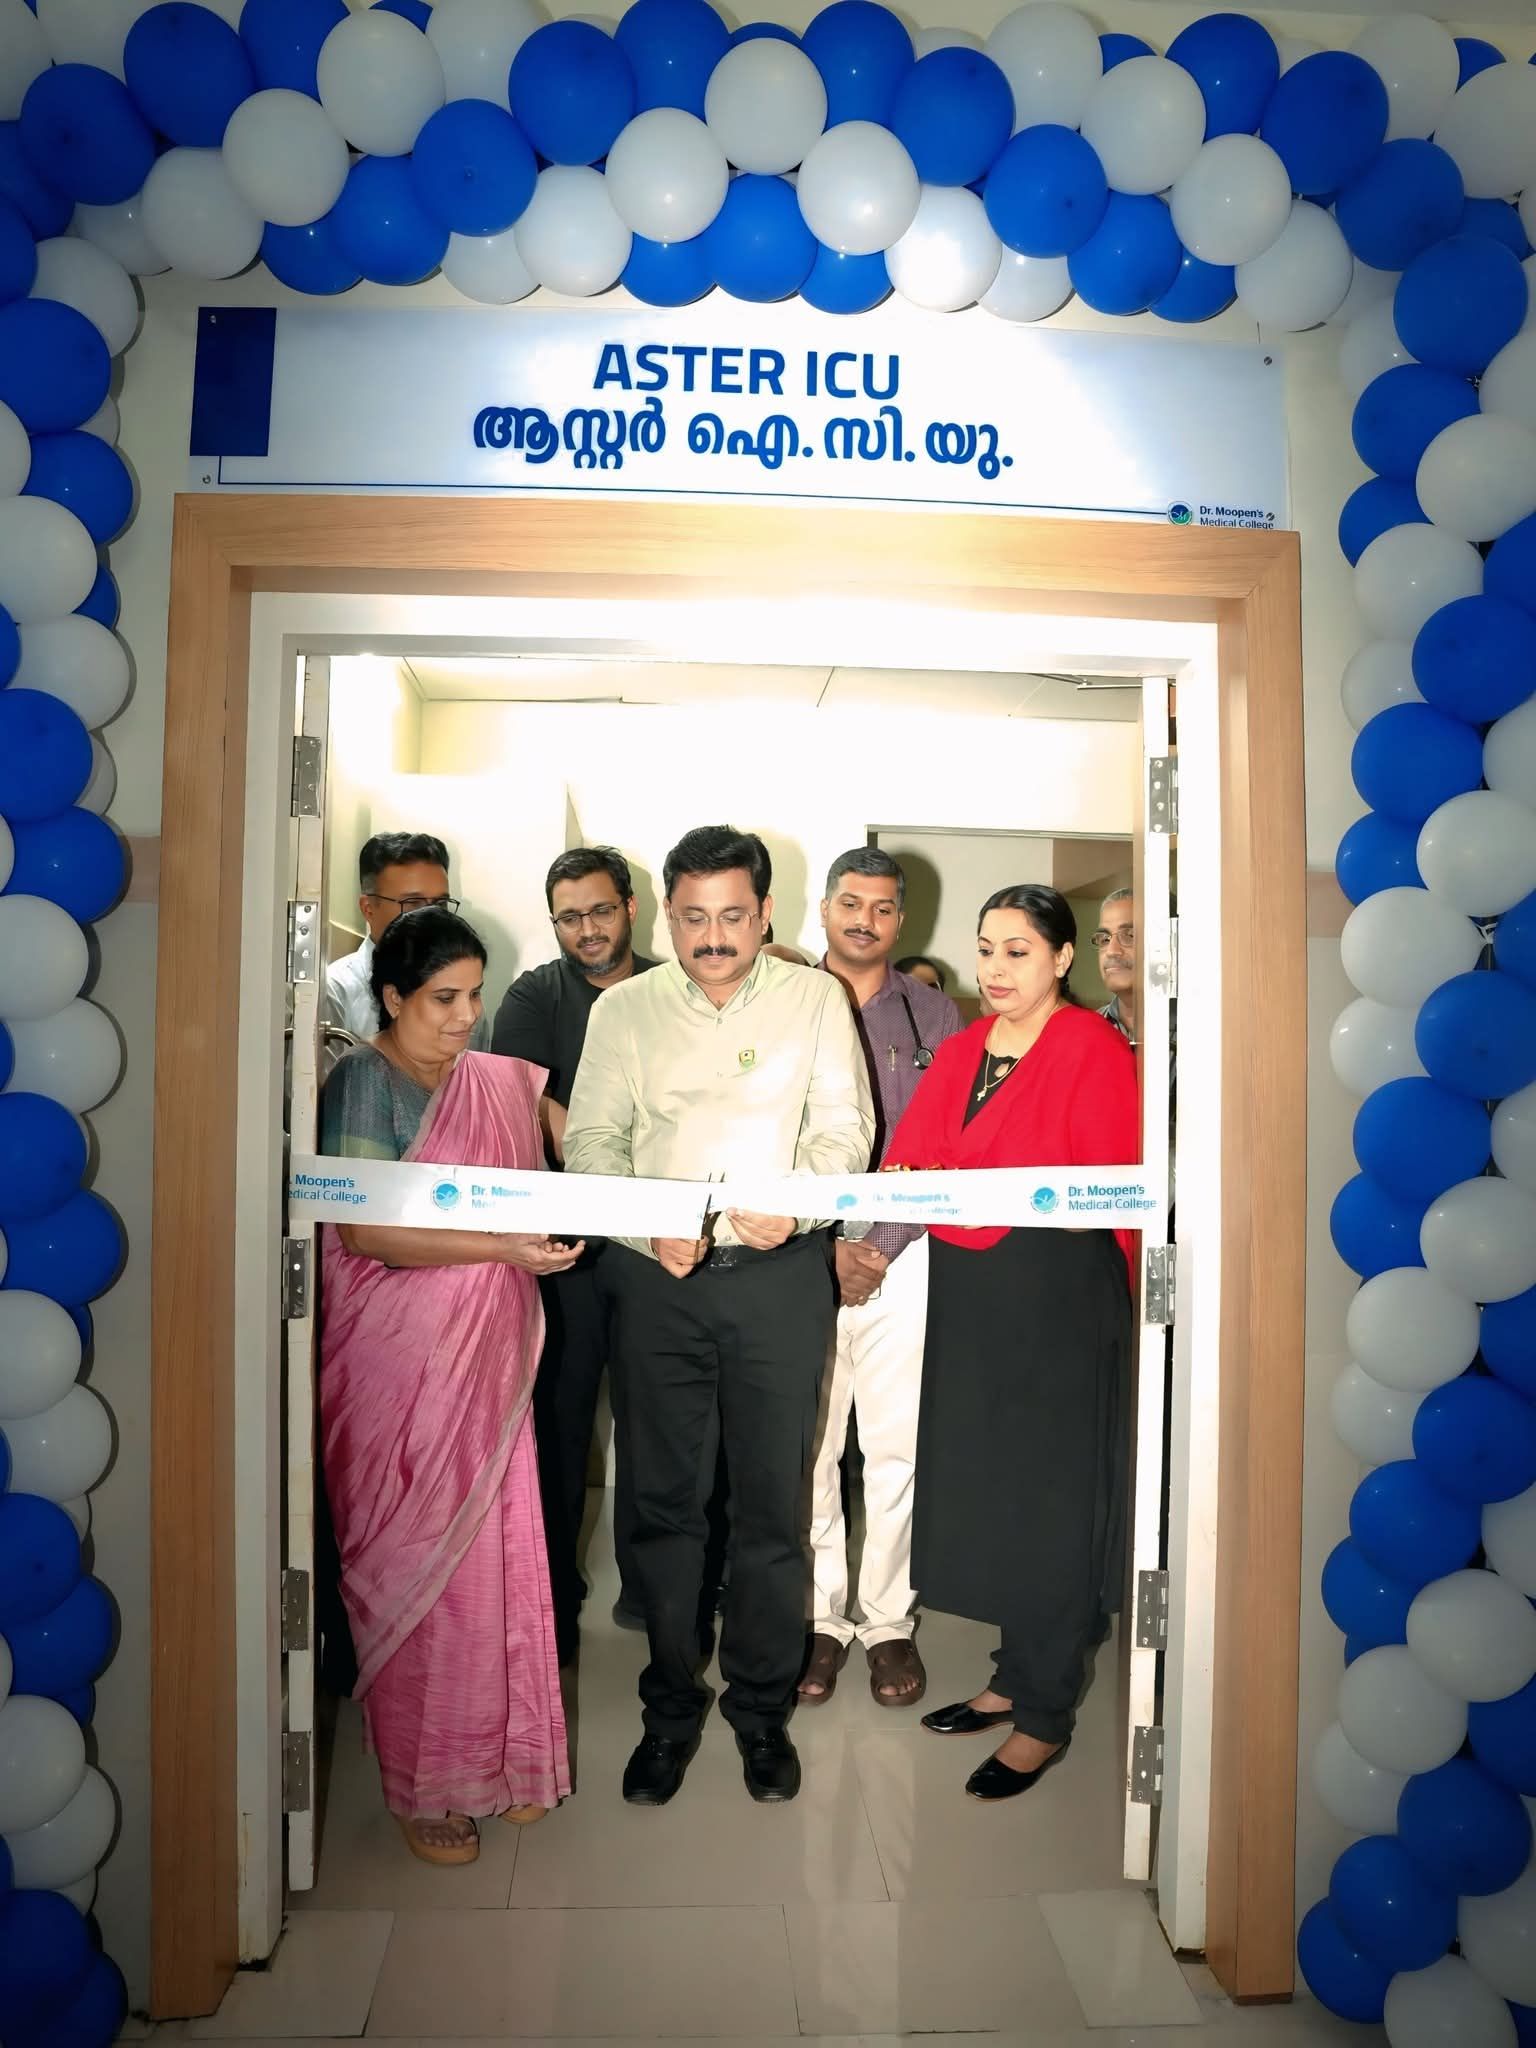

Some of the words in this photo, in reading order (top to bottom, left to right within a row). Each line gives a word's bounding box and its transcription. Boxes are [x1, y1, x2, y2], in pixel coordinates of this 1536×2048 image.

[593, 343, 786, 396] ASTER
[806, 350, 900, 400] ICU
[473, 396, 666, 470] ആസ്റ്റർ
[1199, 505, 1213, 516] Dr.
[1215, 507, 1263, 518] Moopen's
[1199, 517, 1237, 528] Medical
[295, 1174, 355, 1188] Moopen's
[288, 1188, 320, 1200] edical
[323, 1190, 367, 1205] College
[1068, 1186, 1084, 1197] Dr.
[1087, 1184, 1145, 1197] Moopen's
[1068, 1199, 1112, 1211] Medical
[1115, 1198, 1157, 1210] College
